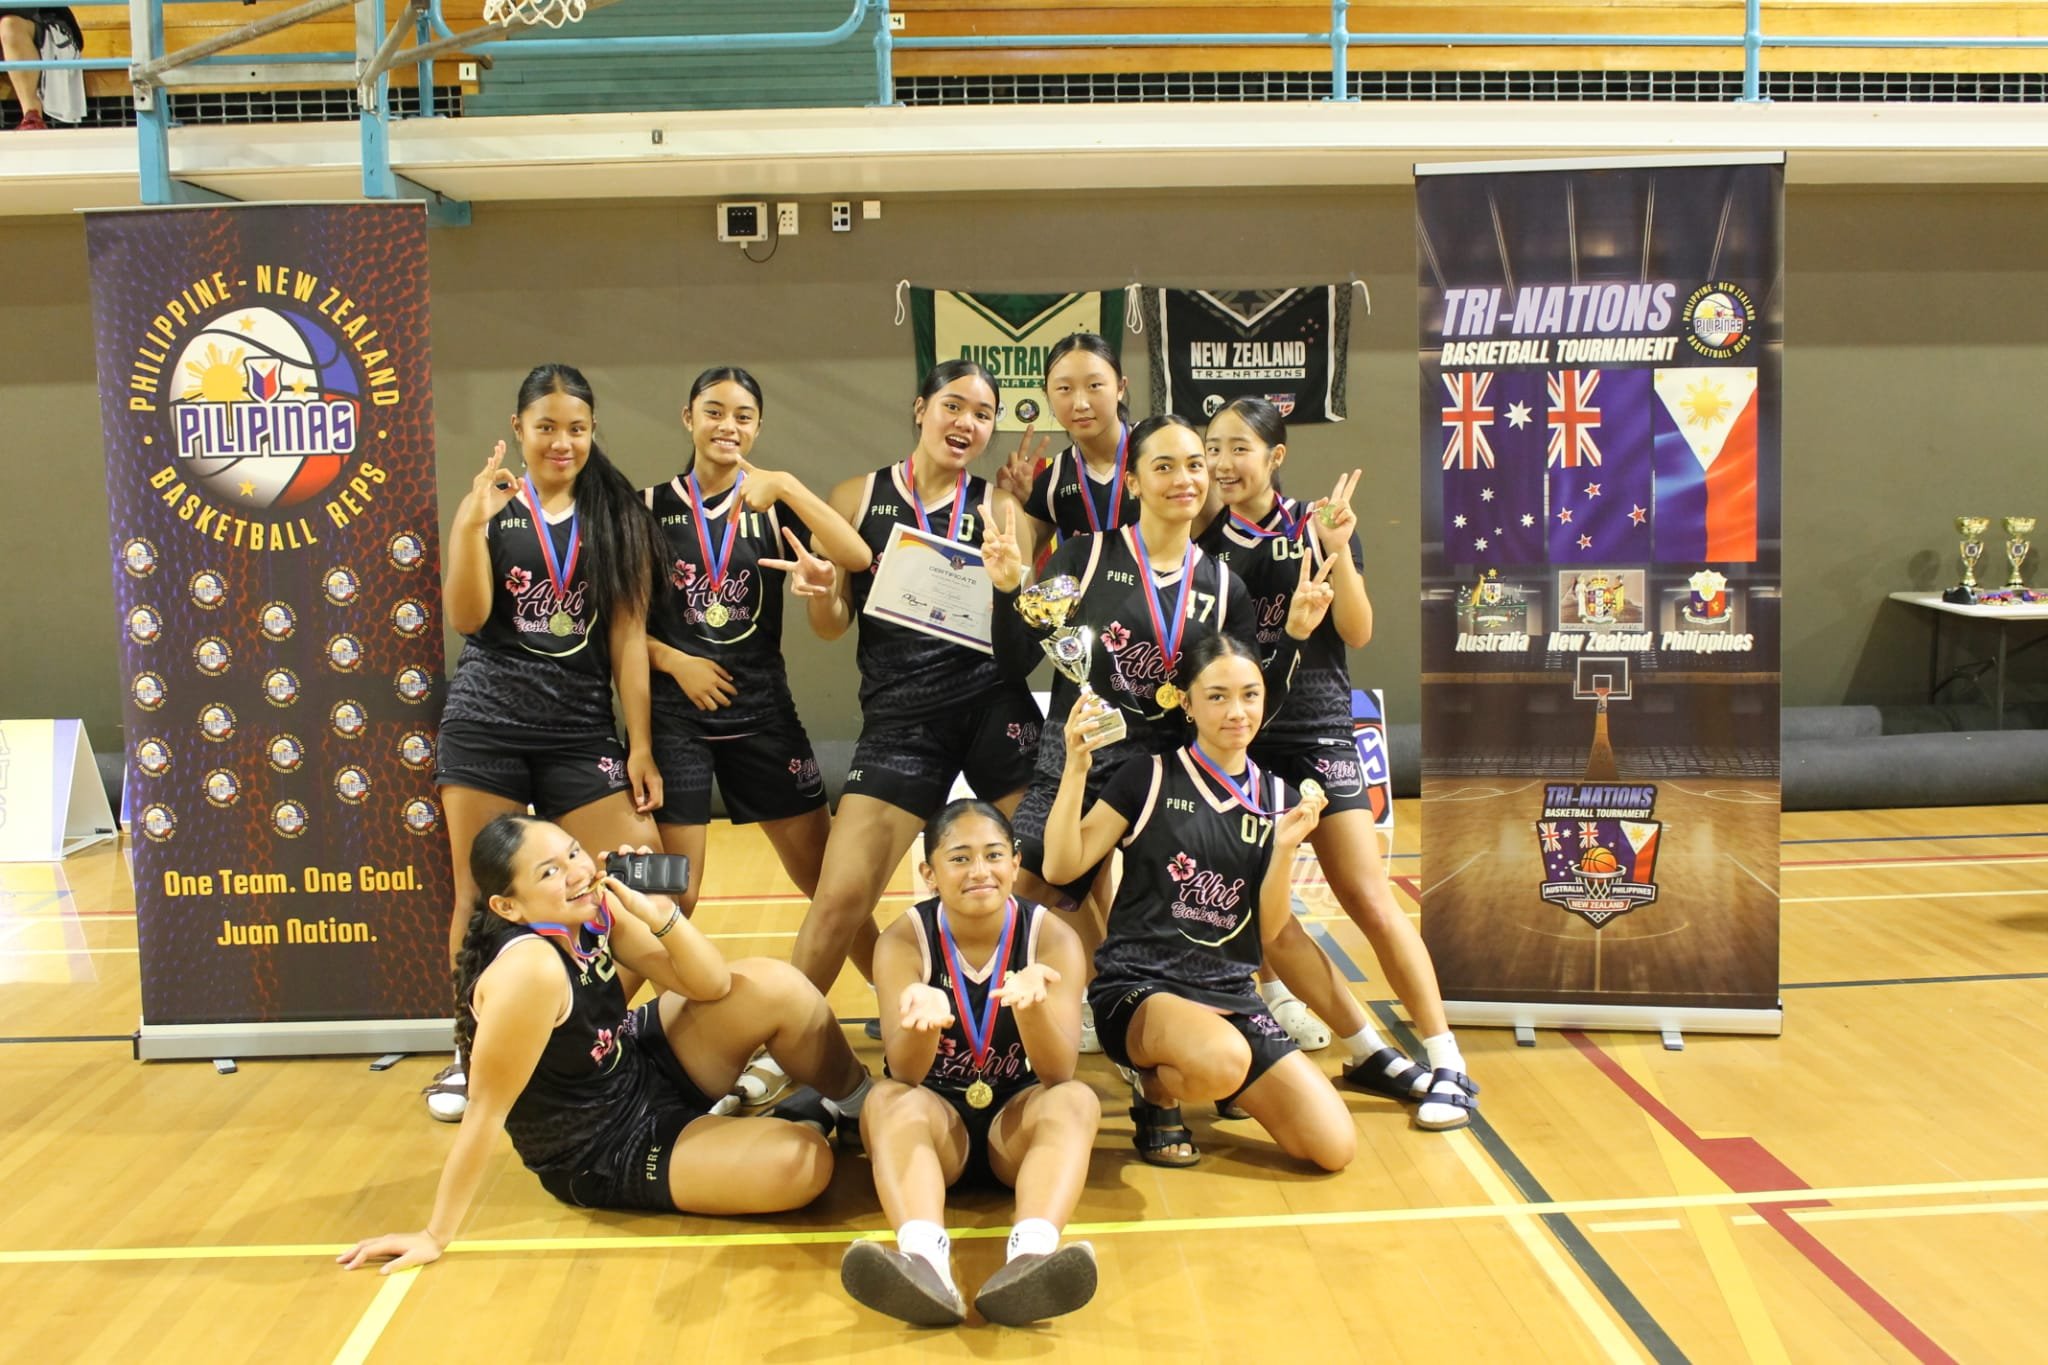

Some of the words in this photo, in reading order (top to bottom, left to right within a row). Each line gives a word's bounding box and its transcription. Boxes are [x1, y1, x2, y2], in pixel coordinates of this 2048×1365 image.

[893, 16, 902, 26] 4
[1441, 282, 1677, 337] TRI-NATIONS
[1682, 283, 1713, 322] PHILIPPINE
[1718, 281, 1736, 292] NEW
[1734, 288, 1756, 321] ZEALAND
[1695, 318, 1744, 333] PILIPINAS
[130, 271, 231, 412] PHILIPPINE
[256, 265, 318, 303] NEW
[317, 287, 400, 407] ZEALAND
[1440, 340, 1551, 366] BASKETBALL
[1555, 336, 1679, 363] TOURNAMENT
[1687, 334, 1732, 359] BASKETBALL
[960, 345, 1050, 376] AUSTRAL
[1190, 341, 1228, 368] NEW
[1233, 340, 1306, 368] ZEALAND
[1195, 369, 1303, 379] TRI-NATIONS
[177, 400, 357, 458] PILIPINAS
[149, 465, 318, 551] BASKETBALL
[325, 461, 387, 529] REPS
[871, 505, 899, 517] PURE
[500, 518, 529, 530] PURE
[661, 514, 689, 528] PURE
[739, 511, 761, 538] 11
[1272, 536, 1305, 562] 03
[1106, 570, 1135, 586] PURE
[1456, 631, 1530, 653] Australia
[1547, 631, 1586, 653] New
[1586, 630, 1653, 653] Zealand
[1660, 630, 1754, 654] Philippines
[1166, 798, 1196, 814] PURE
[1546, 785, 1655, 808] TRI-NATIONS
[1544, 808, 1594, 818] BASKETBALL
[1596, 808, 1651, 819] TOURNAMENT
[1240, 813, 1274, 848] 07
[164, 870, 213, 897] One
[218, 869, 296, 895] Team.
[304, 867, 352, 893] One
[359, 865, 424, 892] Goal.
[1178, 870, 1245, 910] Ahi
[1545, 885, 1584, 895] AUSTRALIA
[1611, 886, 1652, 896] PHILIPPINES
[1571, 900, 1589, 909] NEW
[1590, 900, 1625, 909] ZEALAND
[217, 920, 279, 946] Juan
[286, 917, 378, 944] Nation.
[645, 1145, 663, 1181] PURE
